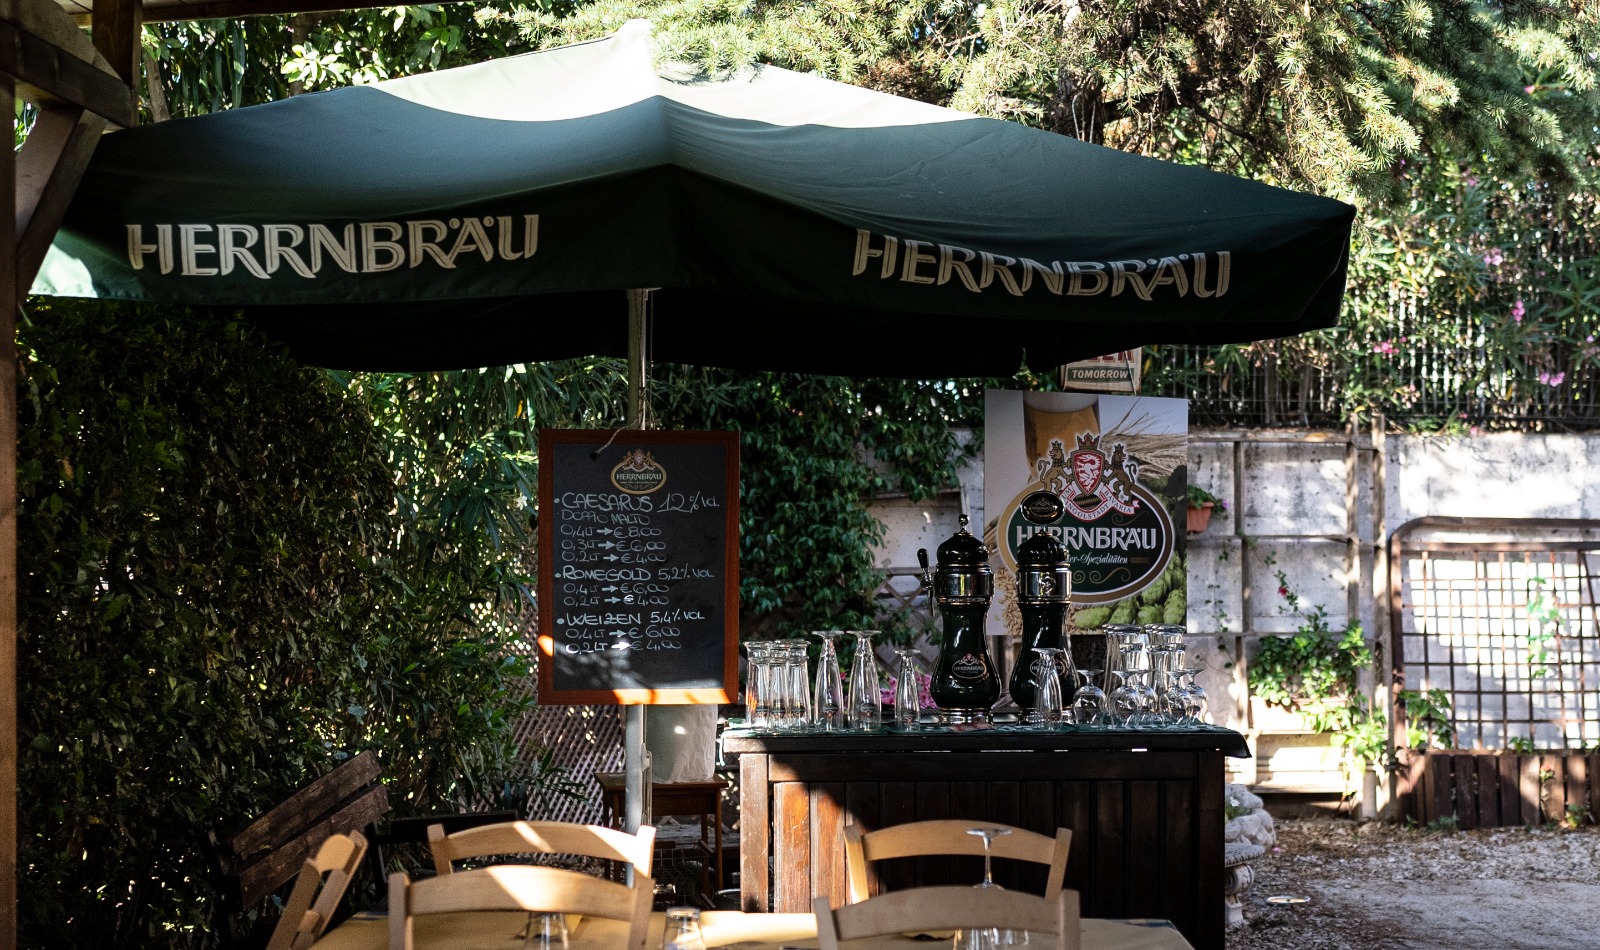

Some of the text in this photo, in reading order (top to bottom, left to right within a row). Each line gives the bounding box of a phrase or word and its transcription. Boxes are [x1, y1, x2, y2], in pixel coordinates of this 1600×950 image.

[126, 213, 540, 280] HERRNBRÄU
[852, 229, 1231, 300] HERRNBRÄU
[1072, 369, 1129, 379] TOMORROW
[616, 473, 662, 481] HERRNBRÄU
[562, 491, 653, 512] CAESARUS
[1065, 501, 1109, 519] INGOLSTADT
[1104, 490, 1132, 513] BAVARIA
[611, 513, 651, 525] MALTO
[562, 565, 652, 581] ROMEGOLD
[692, 568, 715, 578] VOL
[566, 612, 642, 626] WEIZEN
[683, 610, 706, 620] VOL
